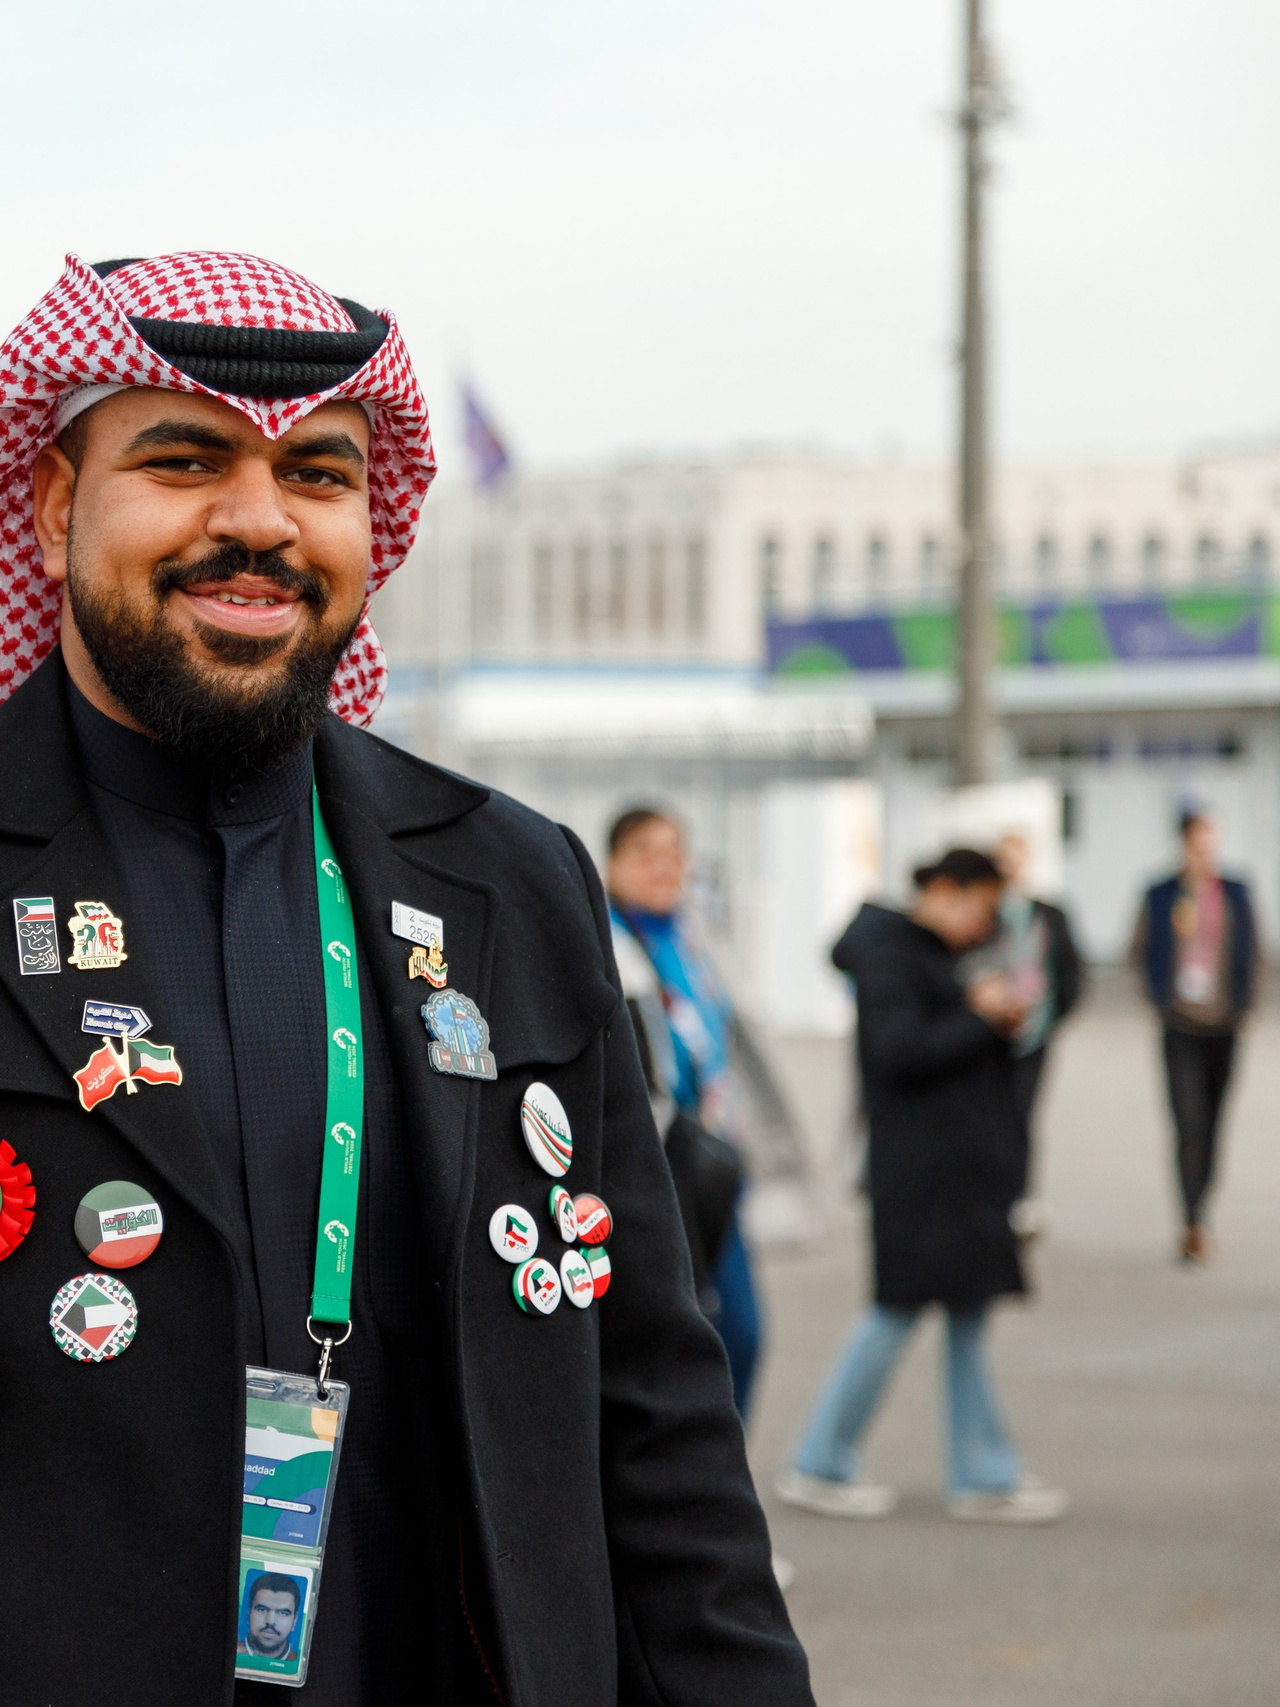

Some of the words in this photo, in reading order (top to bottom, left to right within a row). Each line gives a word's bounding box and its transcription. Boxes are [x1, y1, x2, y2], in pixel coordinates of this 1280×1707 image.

[409, 910, 415, 922] 2
[80, 957, 119, 967] KUWAIT
[452, 1052, 490, 1074] KUWAIT
[86, 1065, 115, 1091] كويت
